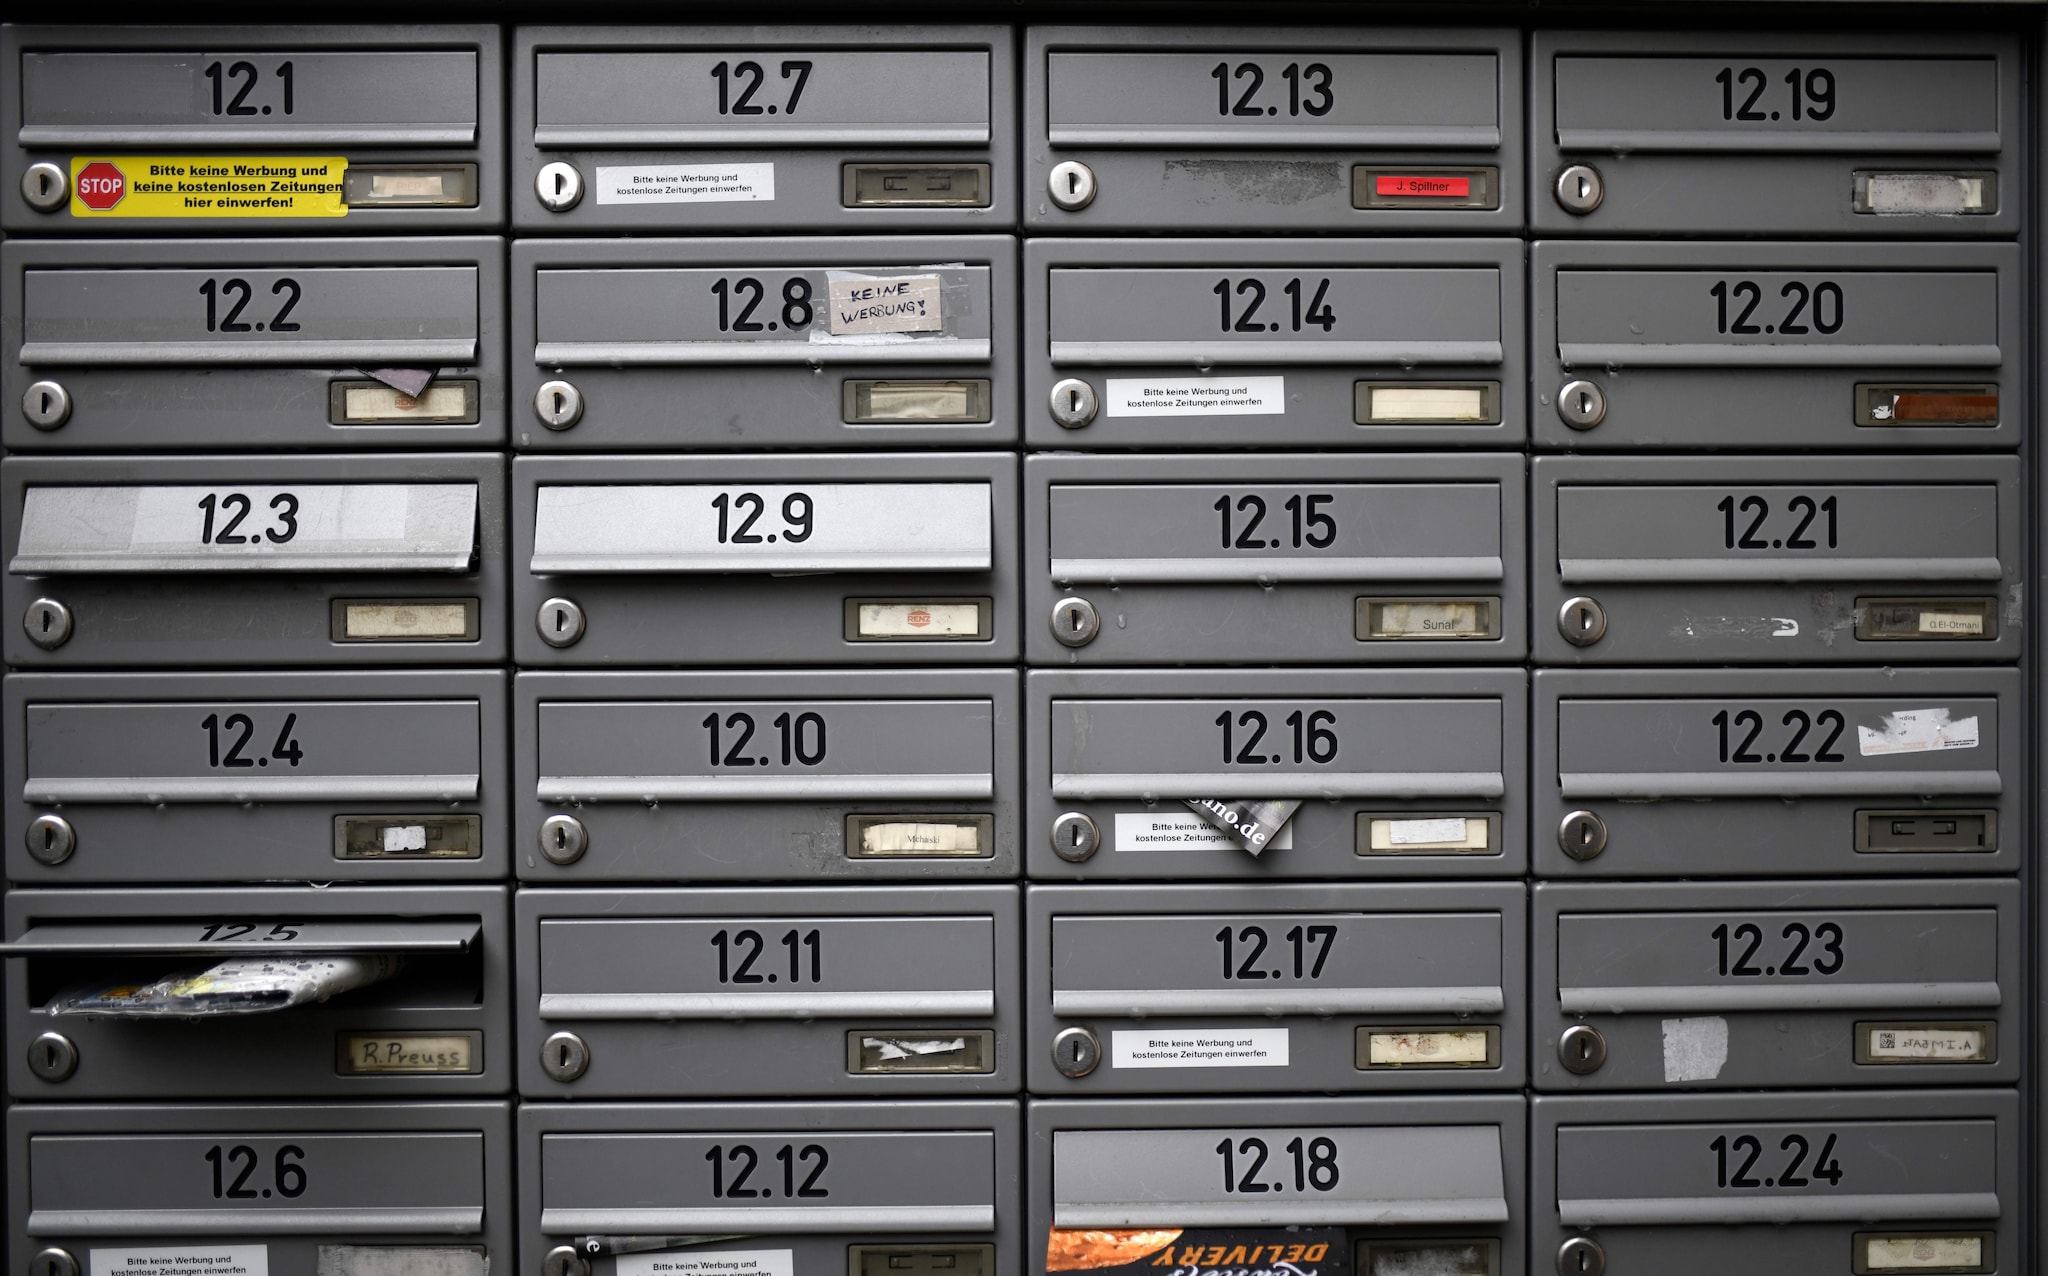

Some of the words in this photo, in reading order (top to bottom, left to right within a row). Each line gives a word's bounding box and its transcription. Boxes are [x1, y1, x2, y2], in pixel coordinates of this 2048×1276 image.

[205, 61, 293, 115] 12.1
[711, 61, 812, 114] 12.7
[1212, 63, 1333, 116] 12.13
[1716, 67, 1835, 121] 12.19
[81, 178, 122, 194] STOP
[134, 181, 173, 192] keine
[178, 181, 266, 192] kostenlosen
[271, 181, 343, 194] Zeitungen
[150, 165, 185, 176] Bitte
[190, 165, 228, 177] keine
[233, 165, 297, 178] Werbung
[302, 165, 327, 176] und
[616, 187, 663, 196] kostenlose
[665, 186, 708, 195] Zeitungen
[710, 185, 752, 193] einwerfen
[633, 176, 653, 184] Bitte
[655, 175, 678, 183] keine
[680, 174, 719, 184] Werbung
[721, 174, 738, 182] und
[1396, 181, 1406, 191] J.
[1409, 181, 1450, 192] Spillner
[184, 197, 212, 208] hier
[217, 197, 293, 208] einwerfen!
[200, 278, 300, 332] 12.2
[712, 278, 813, 331] 12.8
[851, 282, 910, 303] KEINE
[1214, 278, 1336, 332] 12.14
[1711, 281, 1843, 334] 12.20
[1127, 400, 1173, 408] kostenlose
[1175, 399, 1218, 408] Zeitungen
[1220, 398, 1262, 406] einwerfen
[1143, 388, 1164, 396] Bitte
[1166, 388, 1189, 396] keine
[1191, 387, 1230, 397] Werbung
[1231, 387, 1248, 395] und
[199, 493, 298, 544] 12.3
[712, 493, 813, 543] 12.9
[1215, 495, 1336, 548] 12.15
[1718, 496, 1837, 549] 12.21
[907, 615, 931, 623] RENZ
[202, 713, 303, 767] 12.4
[703, 712, 825, 766] 12.10
[1216, 710, 1337, 763] 12.16
[1712, 710, 1844, 762] 12.22
[1135, 834, 1182, 842] kostenlose
[1184, 834, 1227, 843] Zeitungen
[1152, 823, 1172, 831] Bitte
[1175, 822, 1197, 831] keine
[199, 923, 304, 941] 12.5
[711, 930, 820, 983] 12.11
[1216, 926, 1337, 979] 12.17
[1712, 923, 1843, 976] 12.23
[1132, 1051, 1178, 1059] kostenlose
[1180, 1051, 1222, 1060] Zeitungen
[1225, 1050, 1267, 1058] einwerfen
[1149, 1040, 1169, 1048] Bitte
[1196, 1039, 1234, 1048] Werbung
[1236, 1039, 1252, 1047] und
[205, 1145, 306, 1198] 12.6
[706, 1145, 828, 1198] 12.12
[1217, 1137, 1339, 1192] 12.18
[1710, 1134, 1843, 1187] 12.24
[127, 1257, 147, 1265] Bitte
[150, 1257, 173, 1265] keine
[175, 1256, 213, 1265] Werbung
[159, 1268, 201, 1276] Zeitungen
[204, 1266, 246, 1274] einwerfen
[700, 1262, 738, 1270] Werbung
[741, 1260, 757, 1268] und
[1152, 1244, 1329, 1267] DELIVERY
